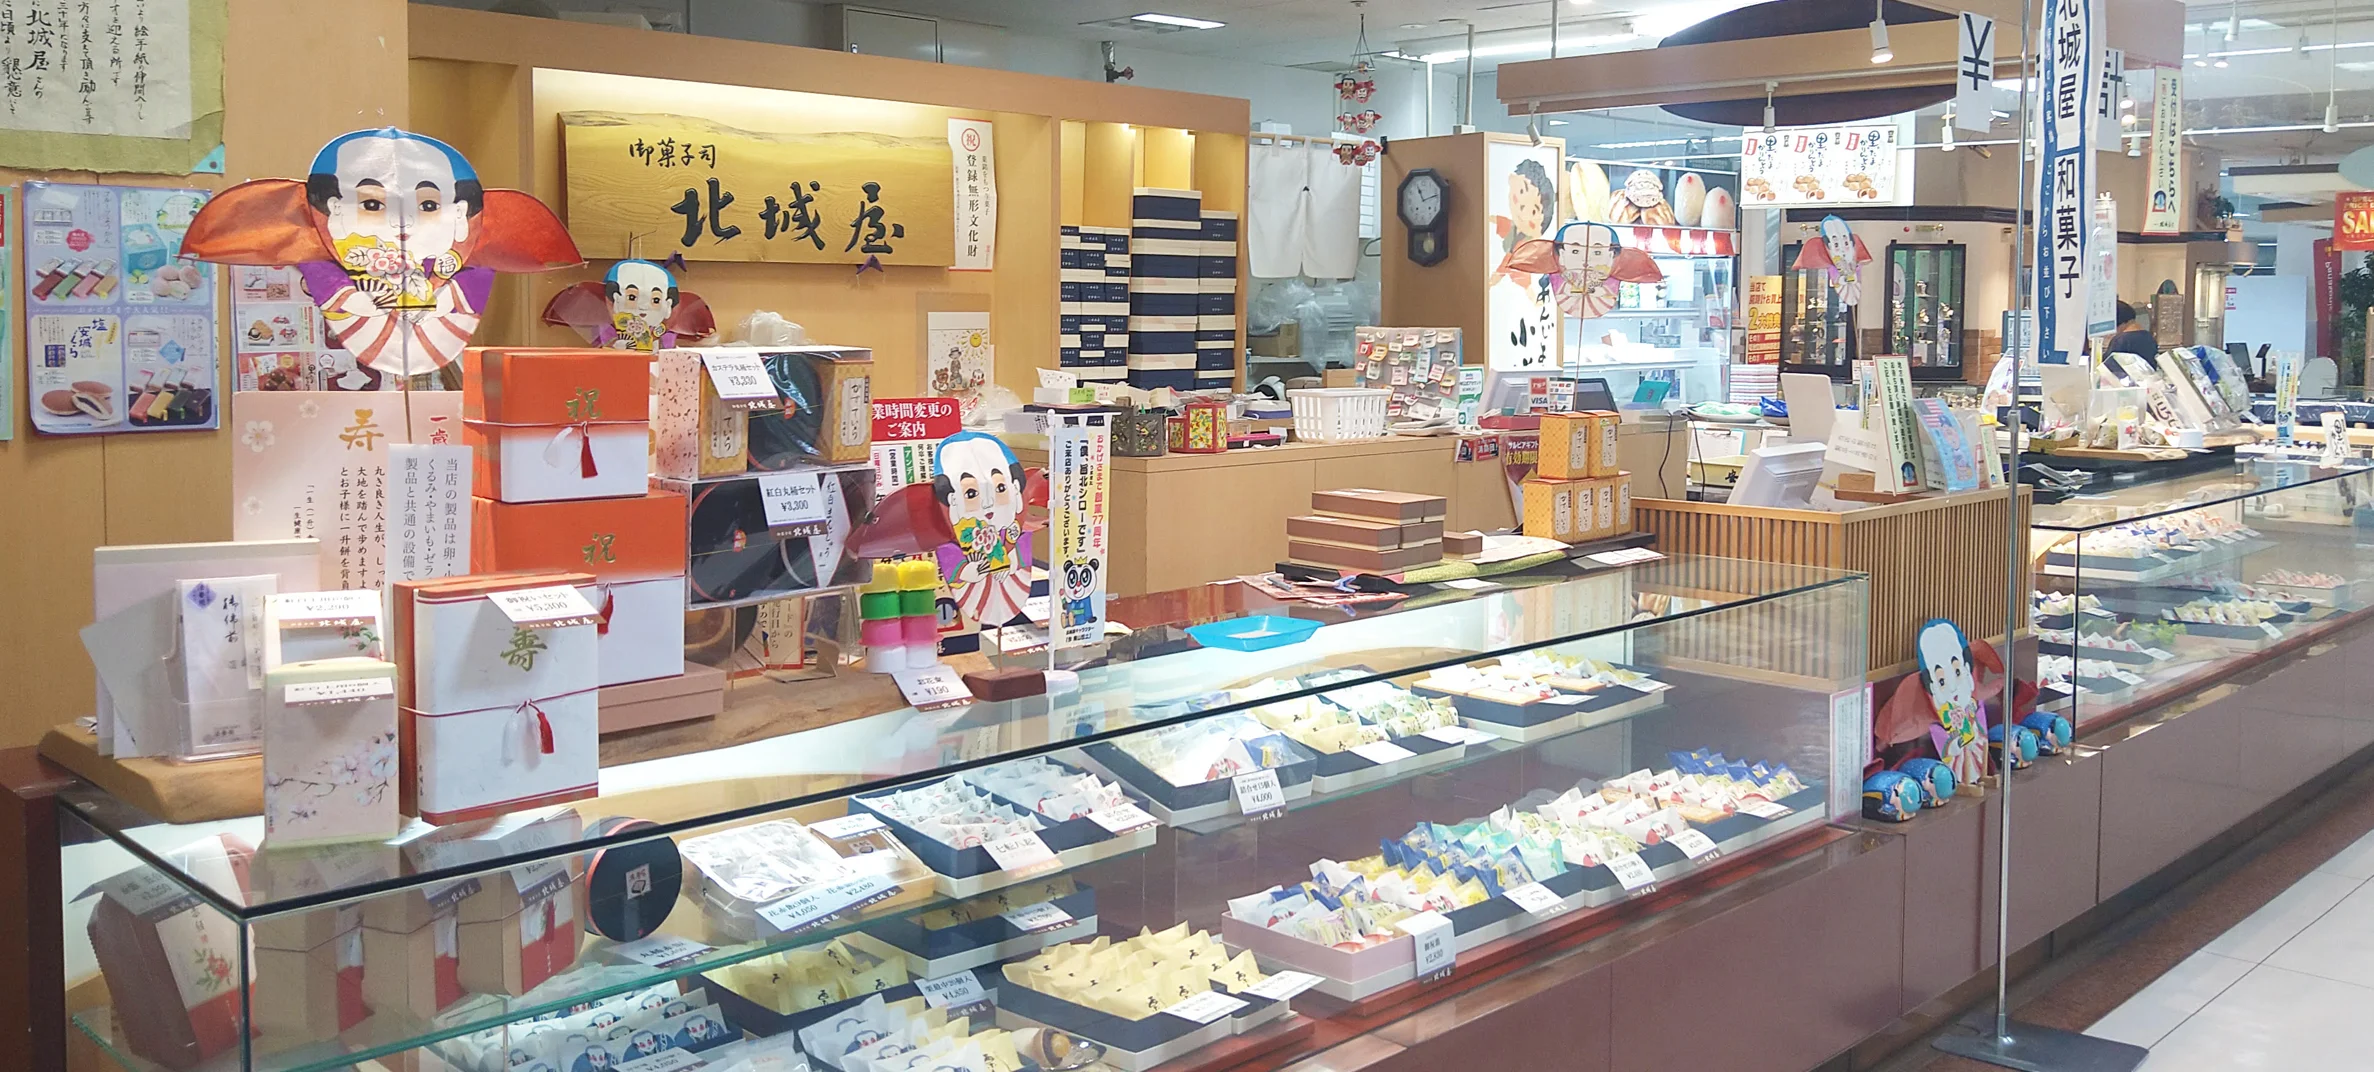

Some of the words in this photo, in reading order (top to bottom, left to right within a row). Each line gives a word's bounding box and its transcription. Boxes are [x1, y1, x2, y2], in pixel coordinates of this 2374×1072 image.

[629, 137, 717, 169] 御菓子司
[670, 177, 905, 255] 北城屋
[966, 154, 980, 258] 登録無形文化財
[2055, 157, 2080, 299] 和菓子
[437, 257, 457, 275] 福
[92, 318, 108, 331] 塩
[1510, 317, 1536, 367] 小
[566, 387, 602, 422] 祝
[871, 398, 953, 421] 業時間変更の
[1531, 397, 1548, 405] VISA
[339, 408, 385, 452] 寿
[886, 420, 927, 438] ご案内
[780, 500, 809, 512] ¥3,300
[1092, 434, 1105, 549] おかげさまで創業77周年
[356, 466, 368, 590] 大地を踏んで歩めますよ
[402, 457, 418, 581] 製品と共通の設備で
[582, 533, 617, 567] 祝
[924, 686, 950, 697] ¥190
